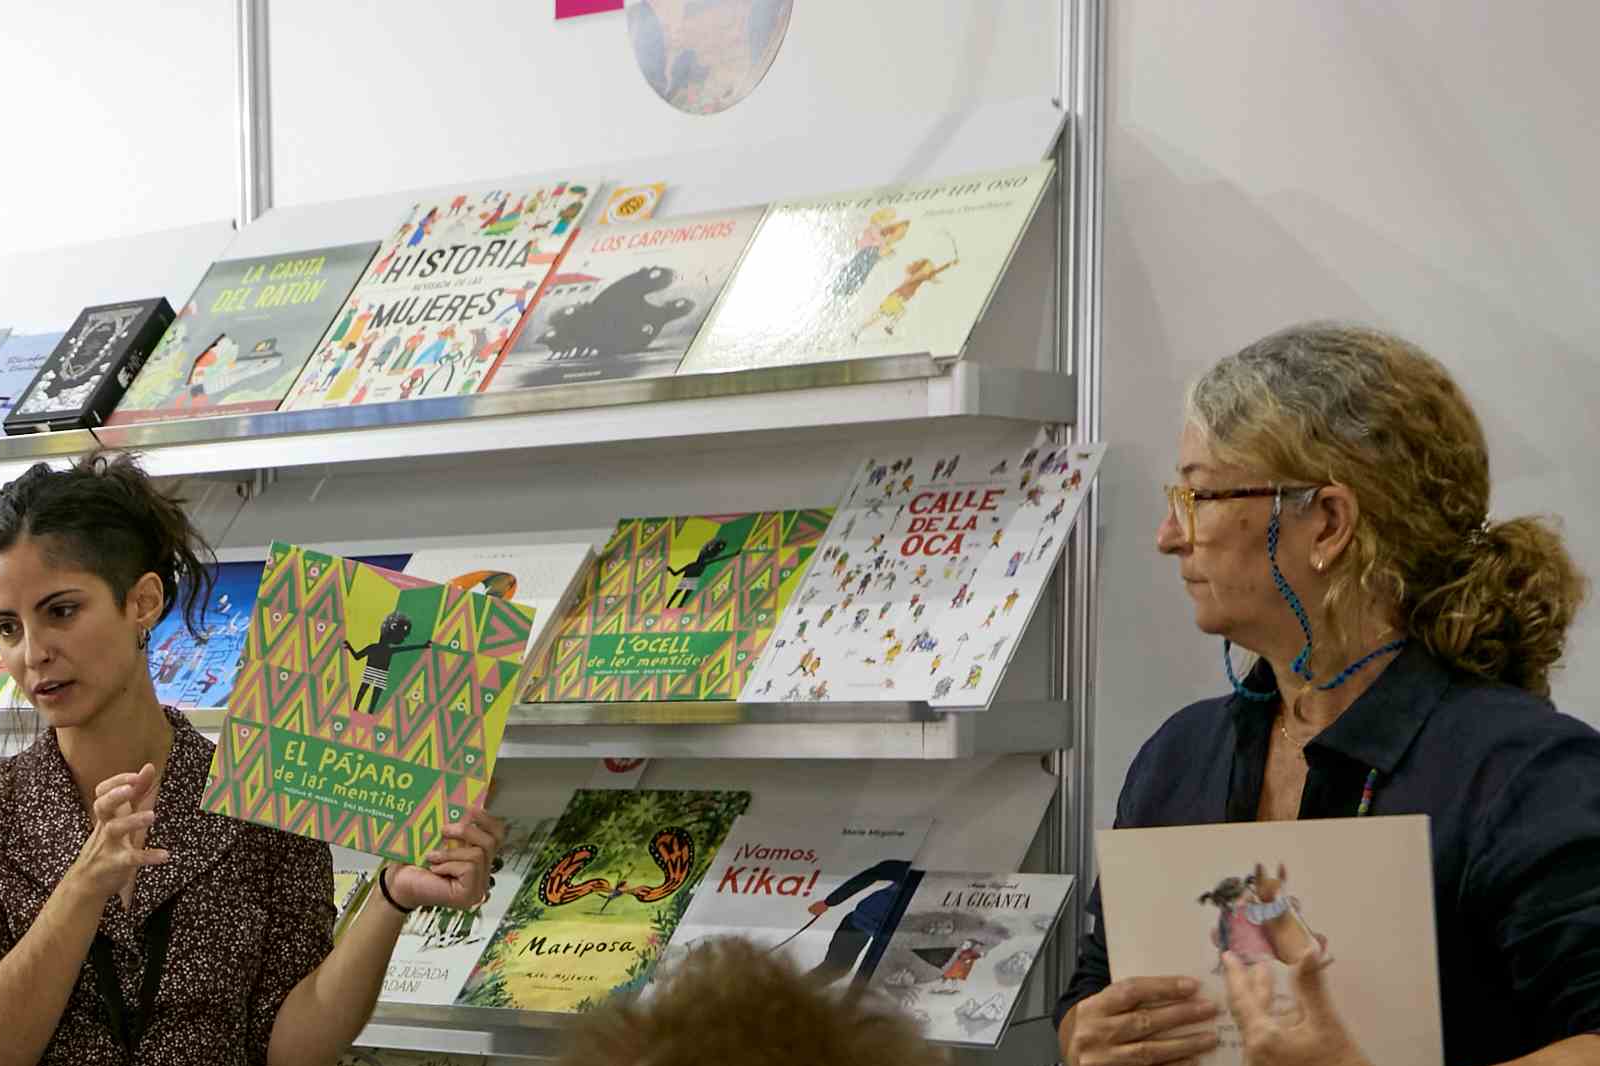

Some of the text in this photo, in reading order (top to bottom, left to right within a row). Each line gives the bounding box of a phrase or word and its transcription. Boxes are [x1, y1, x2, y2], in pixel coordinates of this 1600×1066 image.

[987, 175, 1029, 192] oso
[591, 220, 737, 253] LOS CARPINCHOS
[241, 256, 327, 285] LA CASITA
[381, 239, 530, 285] HISTORIA
[210, 287, 251, 314] DEL
[367, 287, 505, 331] MUJERES
[907, 488, 1006, 516] CALLE
[906, 515, 978, 533] DE LA
[899, 532, 966, 557] OCA
[586, 655, 606, 668] de
[283, 740, 308, 767] EL
[273, 765, 295, 784] de
[300, 770, 328, 791] las
[733, 842, 821, 864] ¡Vamos,
[716, 865, 822, 898] Kika!
[940, 890, 1033, 909] LA GIGANTA
[517, 935, 637, 960] Mariposa
